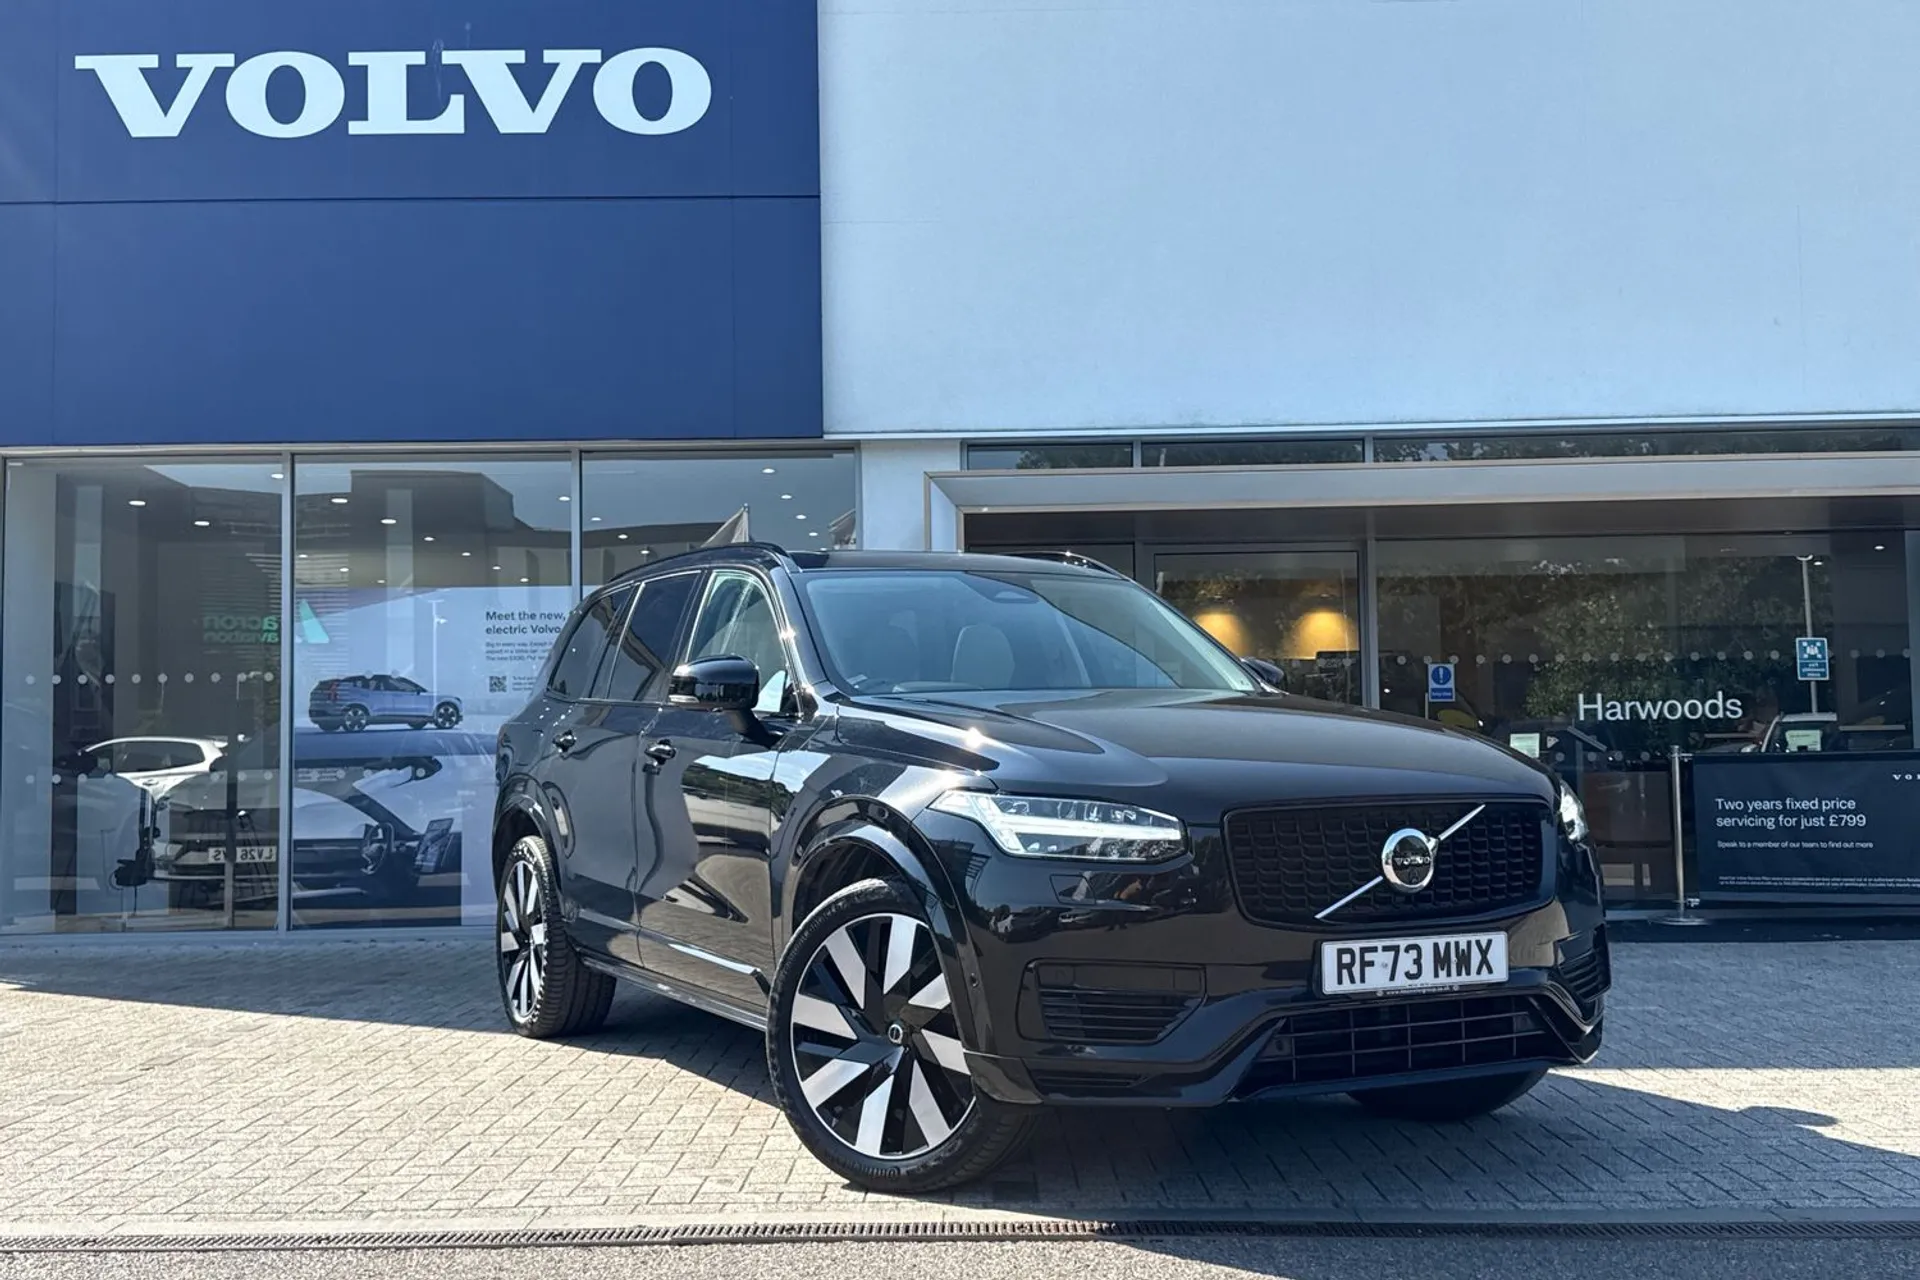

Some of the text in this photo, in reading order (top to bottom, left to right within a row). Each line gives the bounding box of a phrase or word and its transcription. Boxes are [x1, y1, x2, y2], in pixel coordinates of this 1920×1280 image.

[74, 47, 712, 138] VOLVO
[486, 611, 566, 621] Meet the new,
[486, 625, 561, 634] electric Volvo
[1578, 690, 1743, 721] Harwoods
[1715, 798, 1856, 813] Two years fixed price
[1716, 814, 1867, 830] servicing for just £799
[1717, 840, 1738, 849] Speak
[1752, 840, 1780, 848] member
[1781, 840, 1789, 848] of
[1801, 840, 1819, 848] team
[1820, 840, 1828, 848] to
[1828, 840, 1842, 848] find
[1842, 840, 1855, 848] out
[1336, 939, 1493, 985] RF73 MWX
